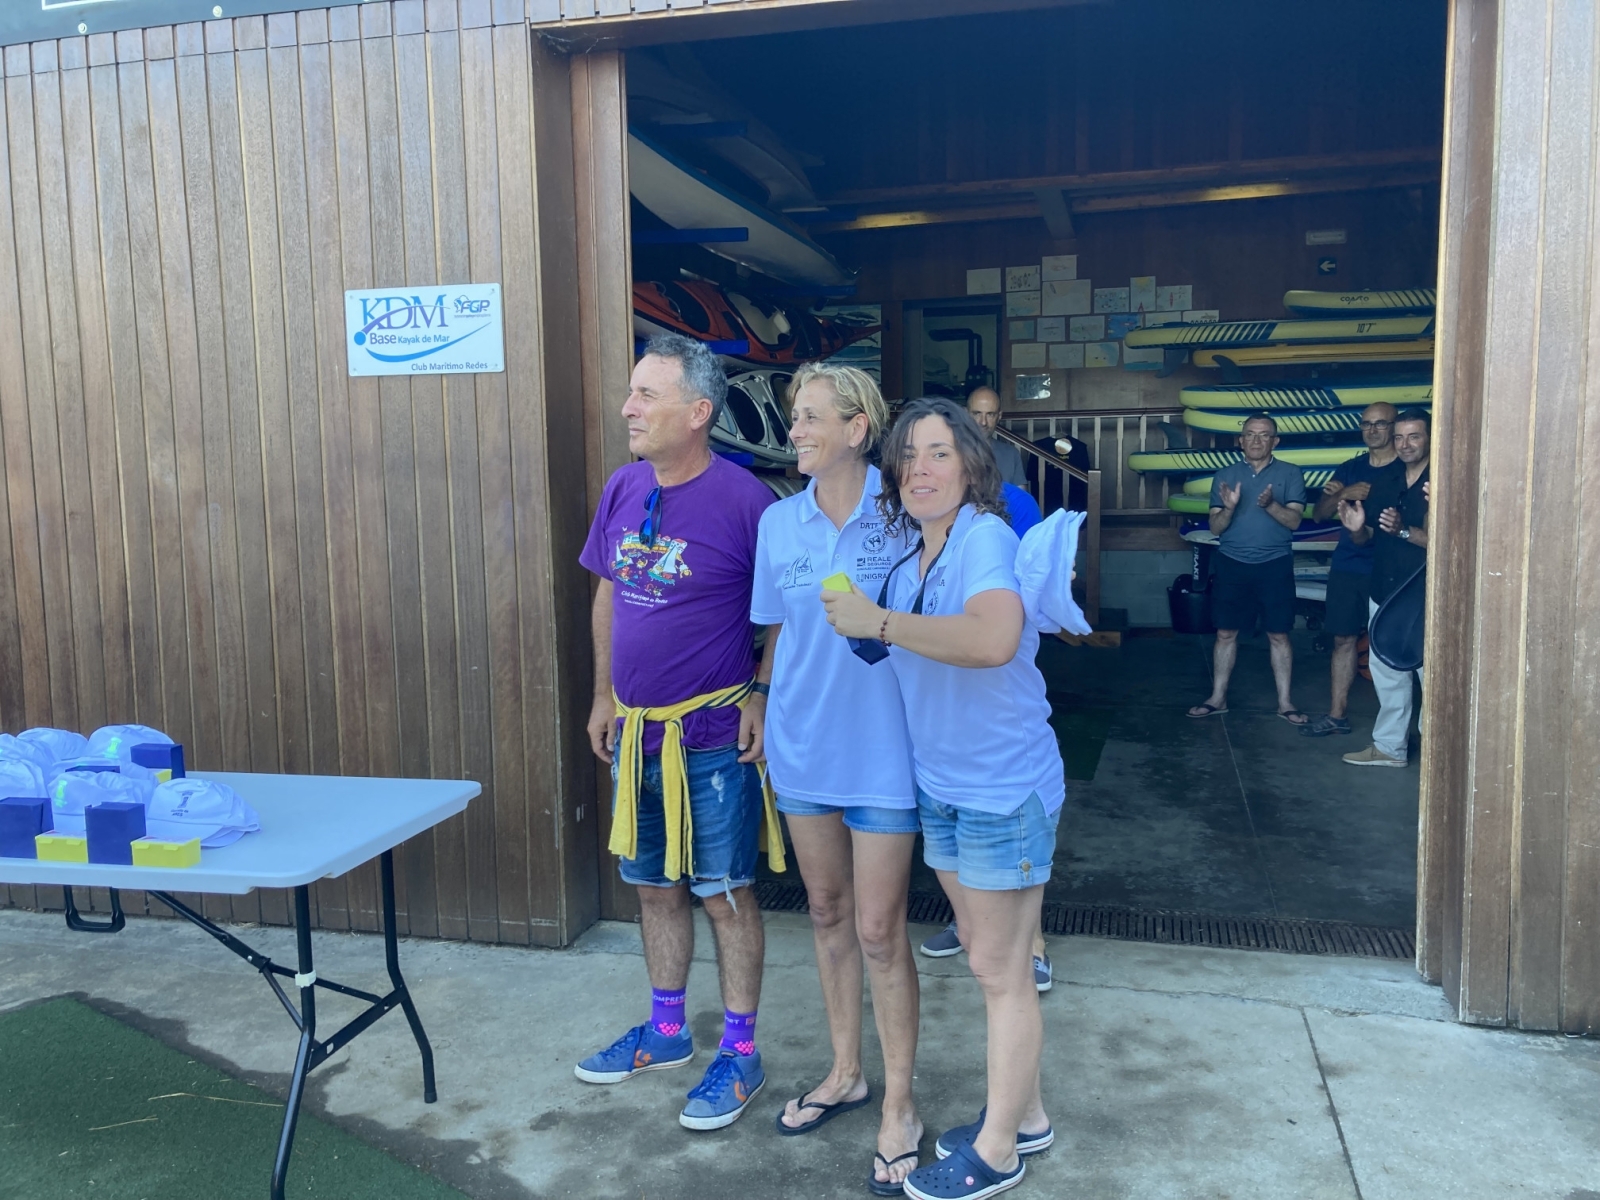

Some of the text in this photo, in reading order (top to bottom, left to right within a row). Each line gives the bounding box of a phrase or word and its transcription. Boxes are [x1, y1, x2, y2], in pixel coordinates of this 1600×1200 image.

[360, 294, 449, 330] KDM
[460, 299, 491, 314] FGP
[370, 333, 397, 345] Base
[398, 336, 420, 345] Kayak
[434, 335, 450, 343] Mar
[411, 363, 428, 371] Club
[466, 361, 488, 370] Redes
